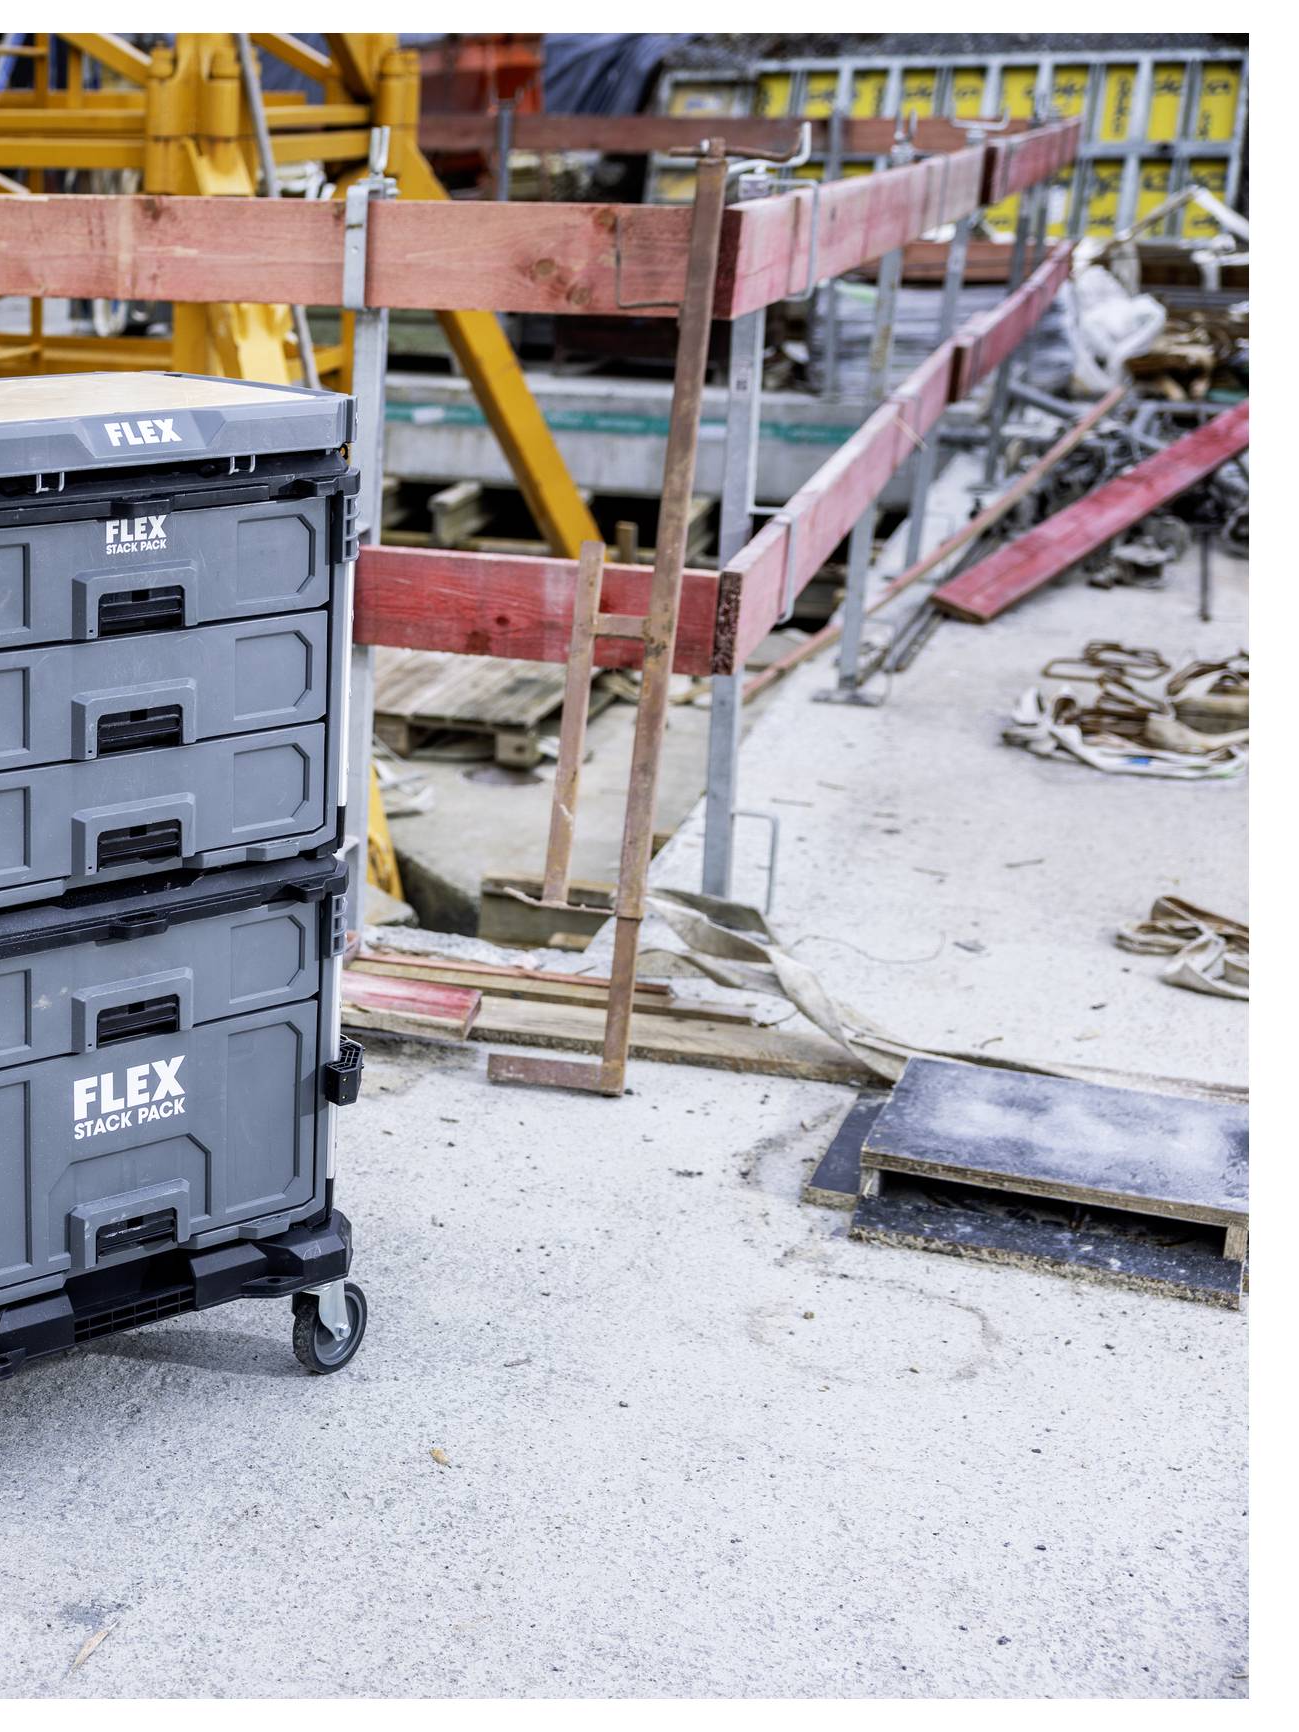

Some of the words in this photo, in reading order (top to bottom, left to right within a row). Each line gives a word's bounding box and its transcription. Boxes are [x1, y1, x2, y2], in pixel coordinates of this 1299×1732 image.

[104, 418, 183, 447] FLEX
[106, 514, 167, 543] FLEX
[106, 542, 138, 555] STACK
[140, 538, 167, 551] PACK
[73, 1055, 186, 1121] FLEX
[74, 1111, 132, 1140] STACK
[138, 1097, 186, 1124] PACK
